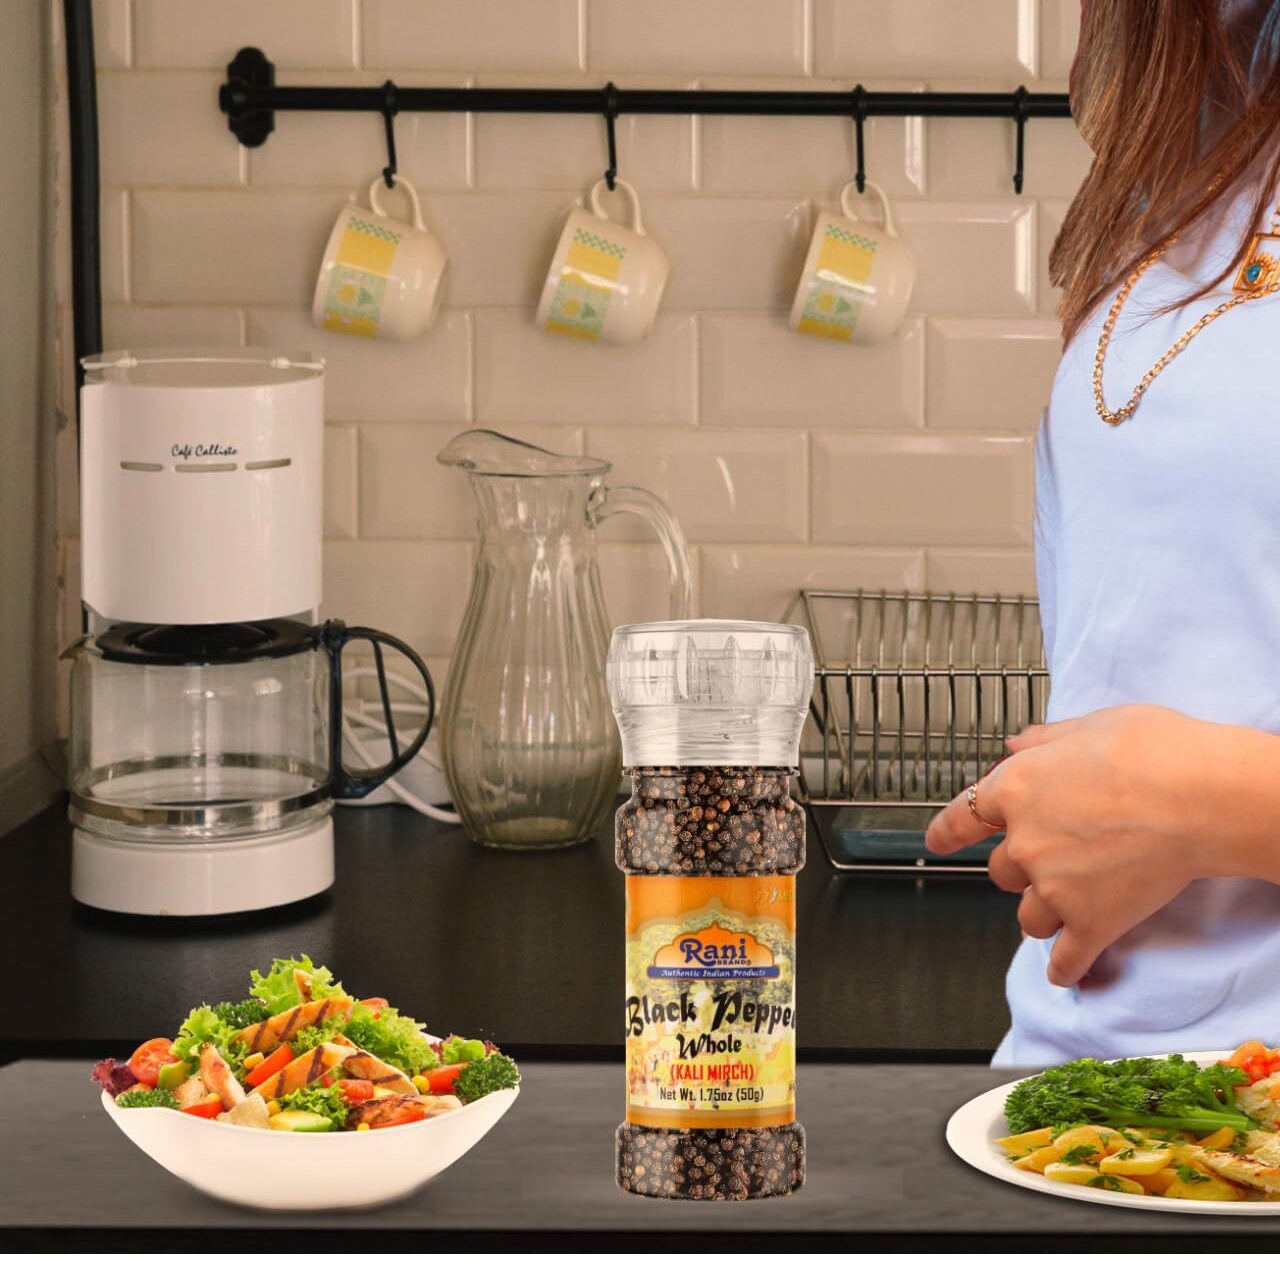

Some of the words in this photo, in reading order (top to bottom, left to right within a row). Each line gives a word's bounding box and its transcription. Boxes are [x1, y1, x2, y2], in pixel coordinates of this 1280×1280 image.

[171, 443, 192, 459] Café
[195, 444, 238, 456] Callisto
[679, 938, 747, 966] Rani
[661, 967, 700, 978] Authentic
[703, 967, 730, 977] Indian
[732, 967, 767, 978] Products
[626, 993, 697, 1037] Black
[676, 1033, 742, 1059] Whole
[670, 1064, 704, 1081] (KALI
[707, 1064, 754, 1081] MIRCH)
[660, 1086, 677, 1100] Net
[680, 1086, 697, 1100] Wt.
[699, 1086, 733, 1101] 1.75oz
[736, 1087, 764, 1102] (50g)
